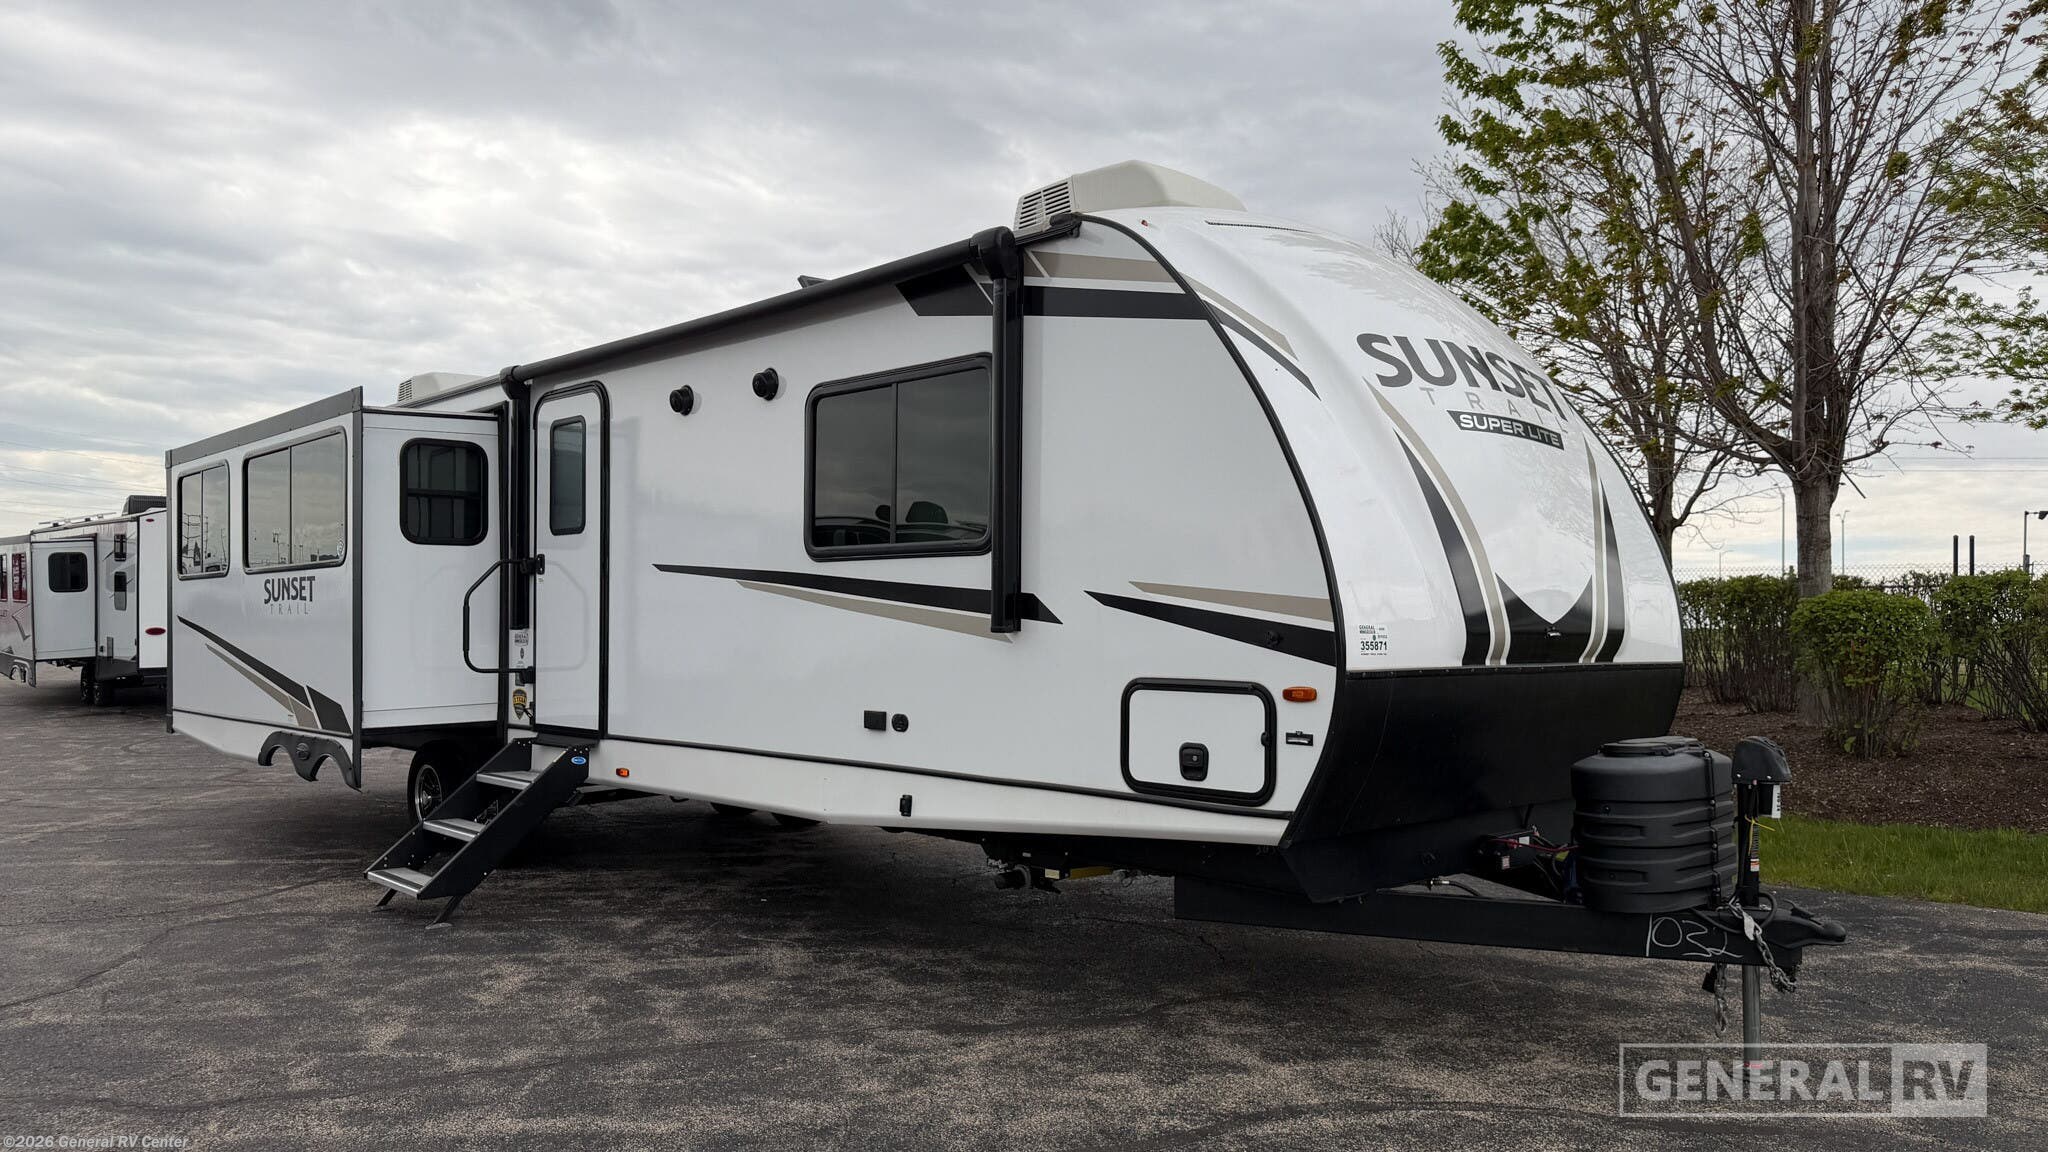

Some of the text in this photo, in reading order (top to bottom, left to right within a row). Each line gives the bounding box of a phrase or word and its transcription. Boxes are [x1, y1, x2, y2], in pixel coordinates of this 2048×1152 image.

[1356, 333, 1568, 422] SUNSET
[1420, 387, 1568, 433] TRAIL
[1459, 414, 1561, 447] SUPER LITE
[264, 575, 316, 605] SUNSET
[270, 602, 309, 615] TRAIL
[1360, 641, 1387, 651] 355871
